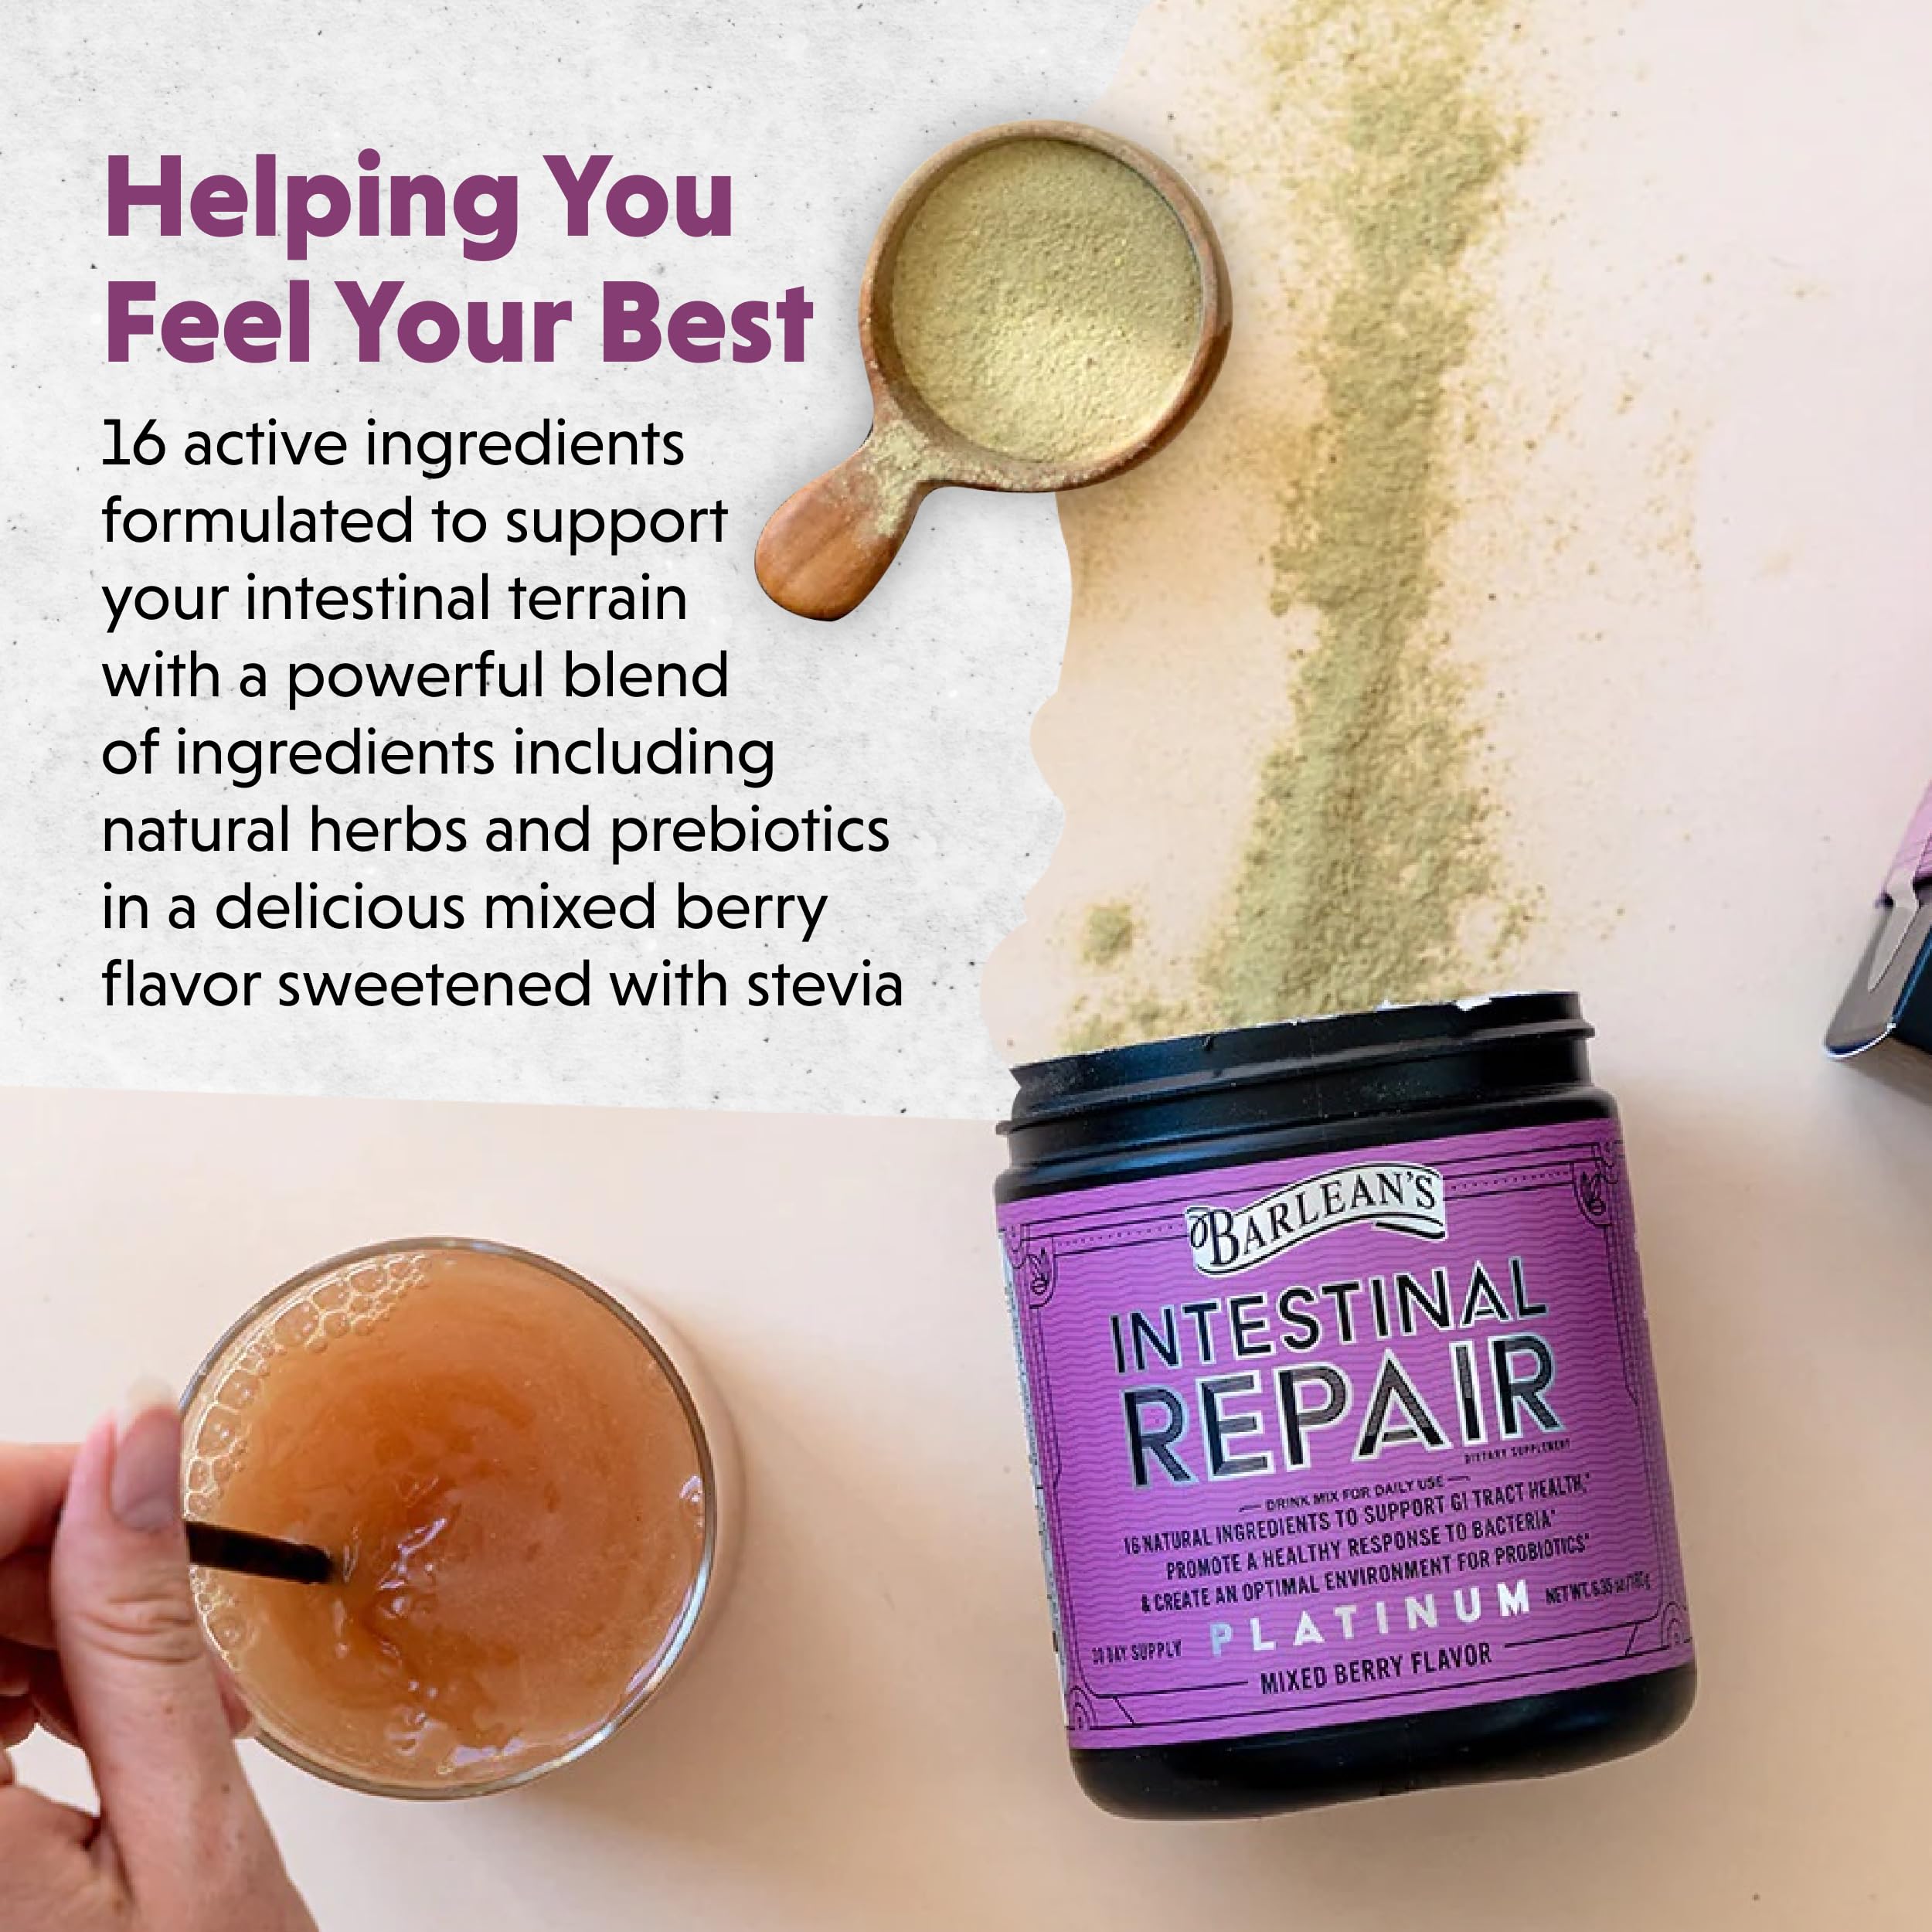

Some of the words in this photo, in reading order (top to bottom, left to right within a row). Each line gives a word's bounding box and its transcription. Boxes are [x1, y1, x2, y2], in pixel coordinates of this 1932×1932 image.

[1189, 1171, 1439, 1267] BARLEAN'S
[1109, 1255, 1549, 1375] INTESTINAL
[1123, 1333, 1565, 1489] REPAIR
[1124, 1535, 1140, 1555] 16
[1141, 1527, 1213, 1553] NATURAL
[1216, 1512, 1331, 1545] INGREDIENTS
[1335, 1508, 1358, 1528] TO
[1364, 1495, 1445, 1525] SUPPORT
[1451, 1492, 1469, 1512] GI
[1471, 1481, 1525, 1508] TRACT
[1266, 1495, 1311, 1512] DRINK
[1313, 1491, 1340, 1505] MIX
[1342, 1485, 1371, 1500] FOR
[1374, 1479, 1414, 1496] DAILY
[1417, 1475, 1444, 1490] USE
[1141, 1594, 1151, 1614] &
[1155, 1587, 1211, 1612] CREATE
[1216, 1585, 1237, 1605] AN
[1242, 1575, 1320, 1603] OPTIMAL
[1325, 1554, 1451, 1591] ENVIRONMENT
[1457, 1549, 1491, 1571] FOR
[1166, 1553, 1241, 1580] PROMOTE
[1247, 1552, 1258, 1570] A
[1262, 1539, 1341, 1568] HEALTHY
[1347, 1526, 1440, 1557] RESPONSE
[1445, 1522, 1468, 1542] TO
[1130, 1638, 1182, 1661] SUPPLY
[1210, 1579, 1530, 1656] PLATINUM
[1261, 1665, 1328, 1695] MIXED
[1335, 1655, 1403, 1685] BERRY
[1411, 1641, 1492, 1674] FLAVOR
